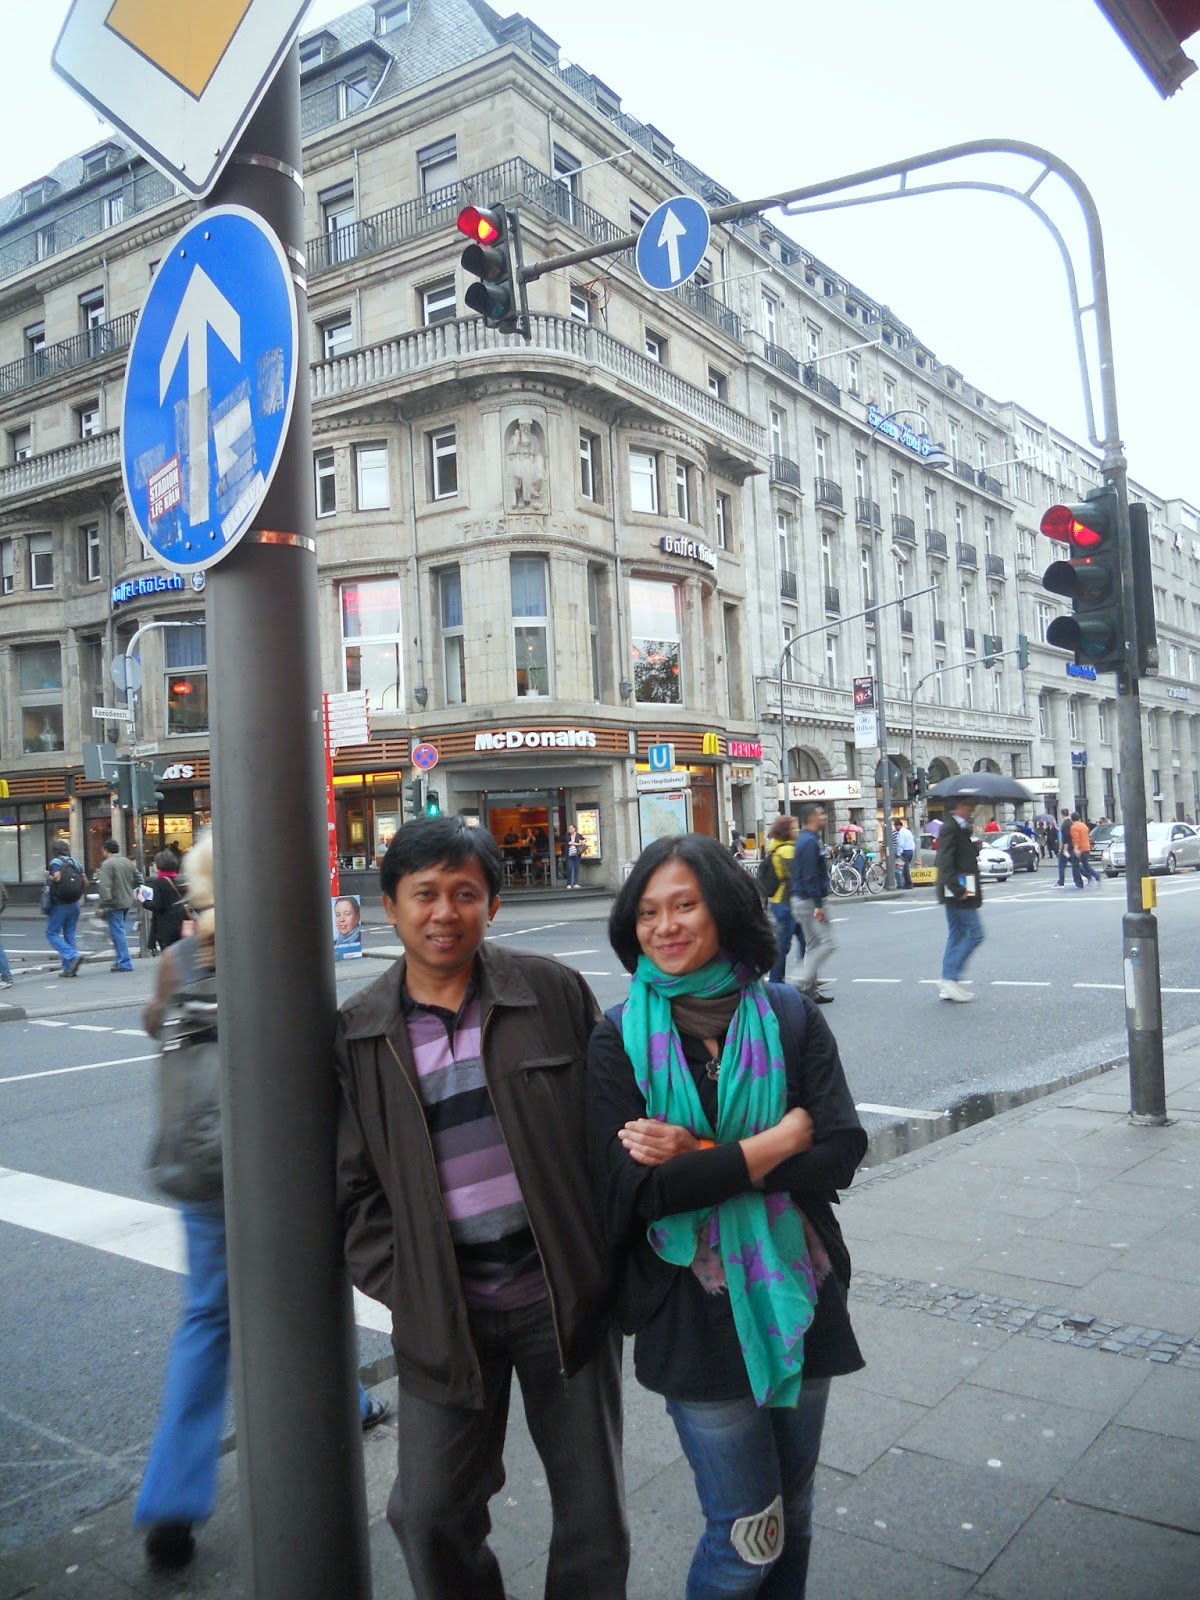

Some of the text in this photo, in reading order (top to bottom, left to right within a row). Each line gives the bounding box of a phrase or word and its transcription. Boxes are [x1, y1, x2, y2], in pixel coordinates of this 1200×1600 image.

[150, 467, 178, 502] STADION
[665, 535, 698, 558] Gaffel
[94, 708, 127, 719] Komödienstr.
[474, 730, 597, 751] McDonald's
[731, 741, 763, 759] PEKING
[653, 748, 667, 768] U
[791, 785, 826, 797] taku
